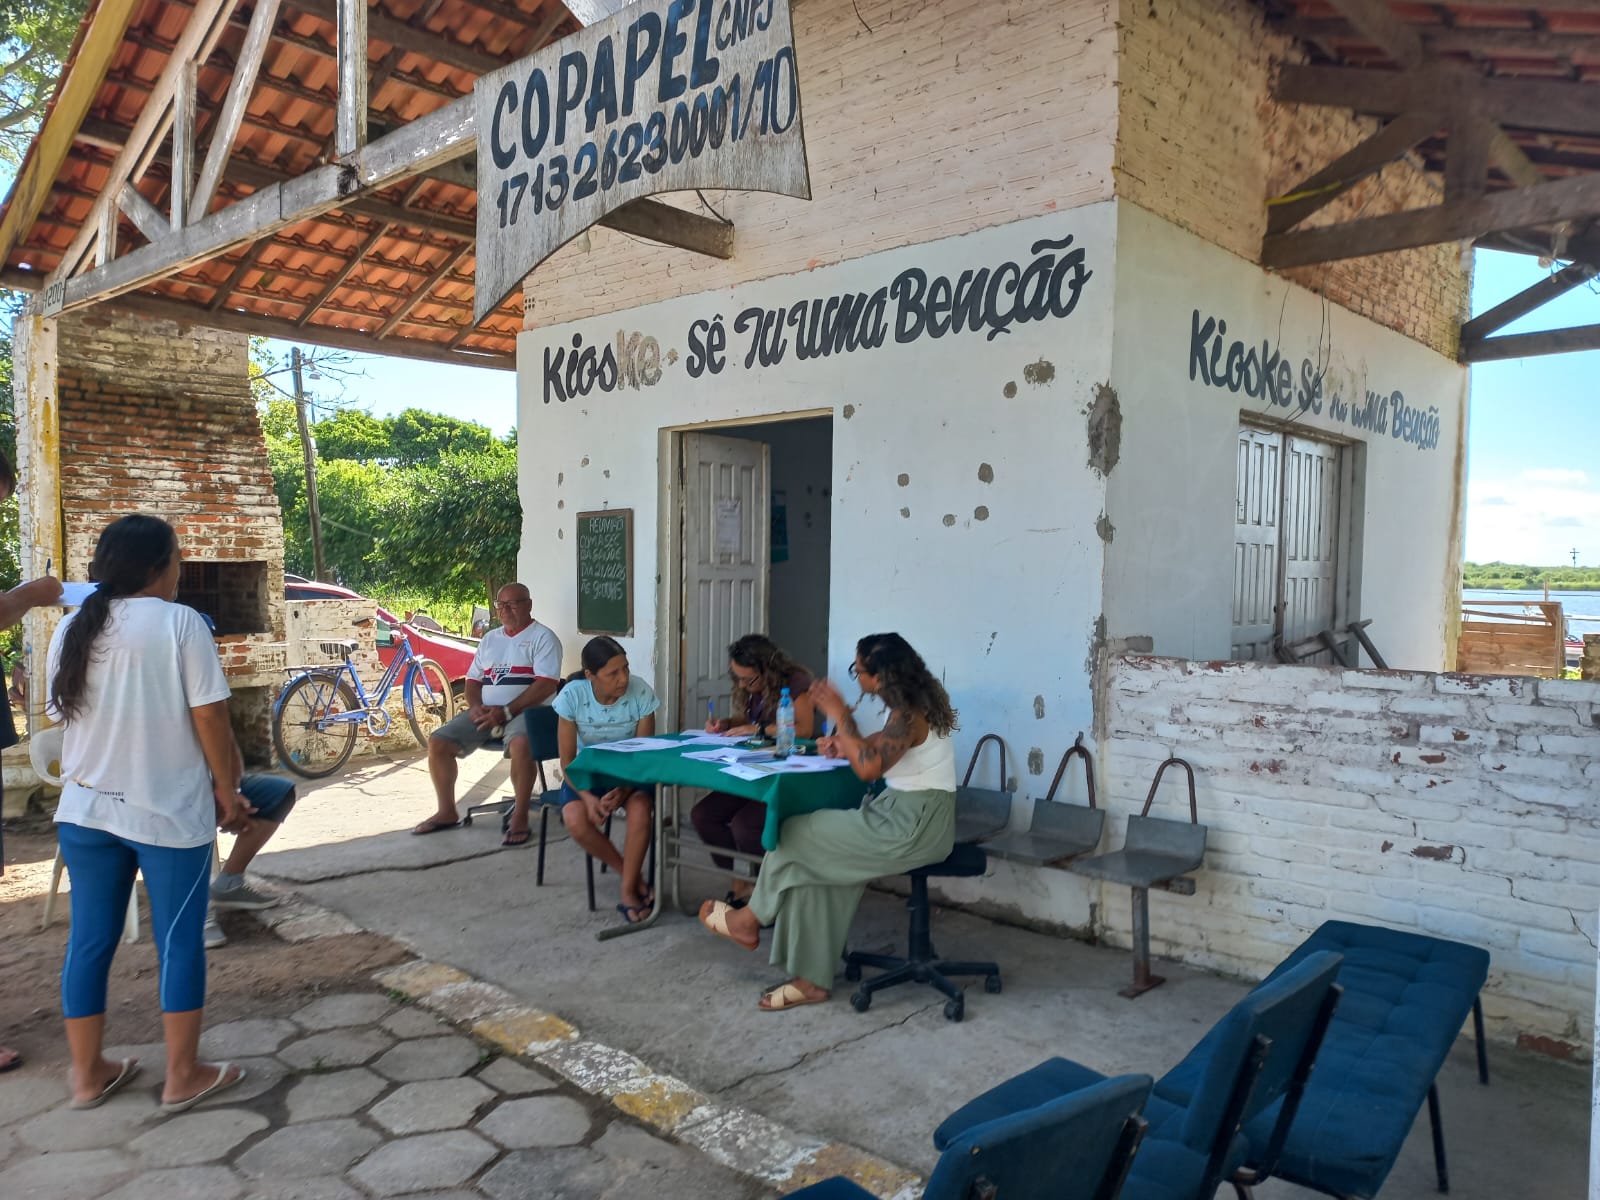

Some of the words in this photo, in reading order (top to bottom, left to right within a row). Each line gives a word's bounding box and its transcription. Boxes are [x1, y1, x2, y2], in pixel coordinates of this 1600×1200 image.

[491, 0, 720, 169] COPAPEL
[715, 0, 774, 51] CNPJ
[497, 46, 797, 229] 171326230001/10
[889, 234, 1093, 344] Benção
